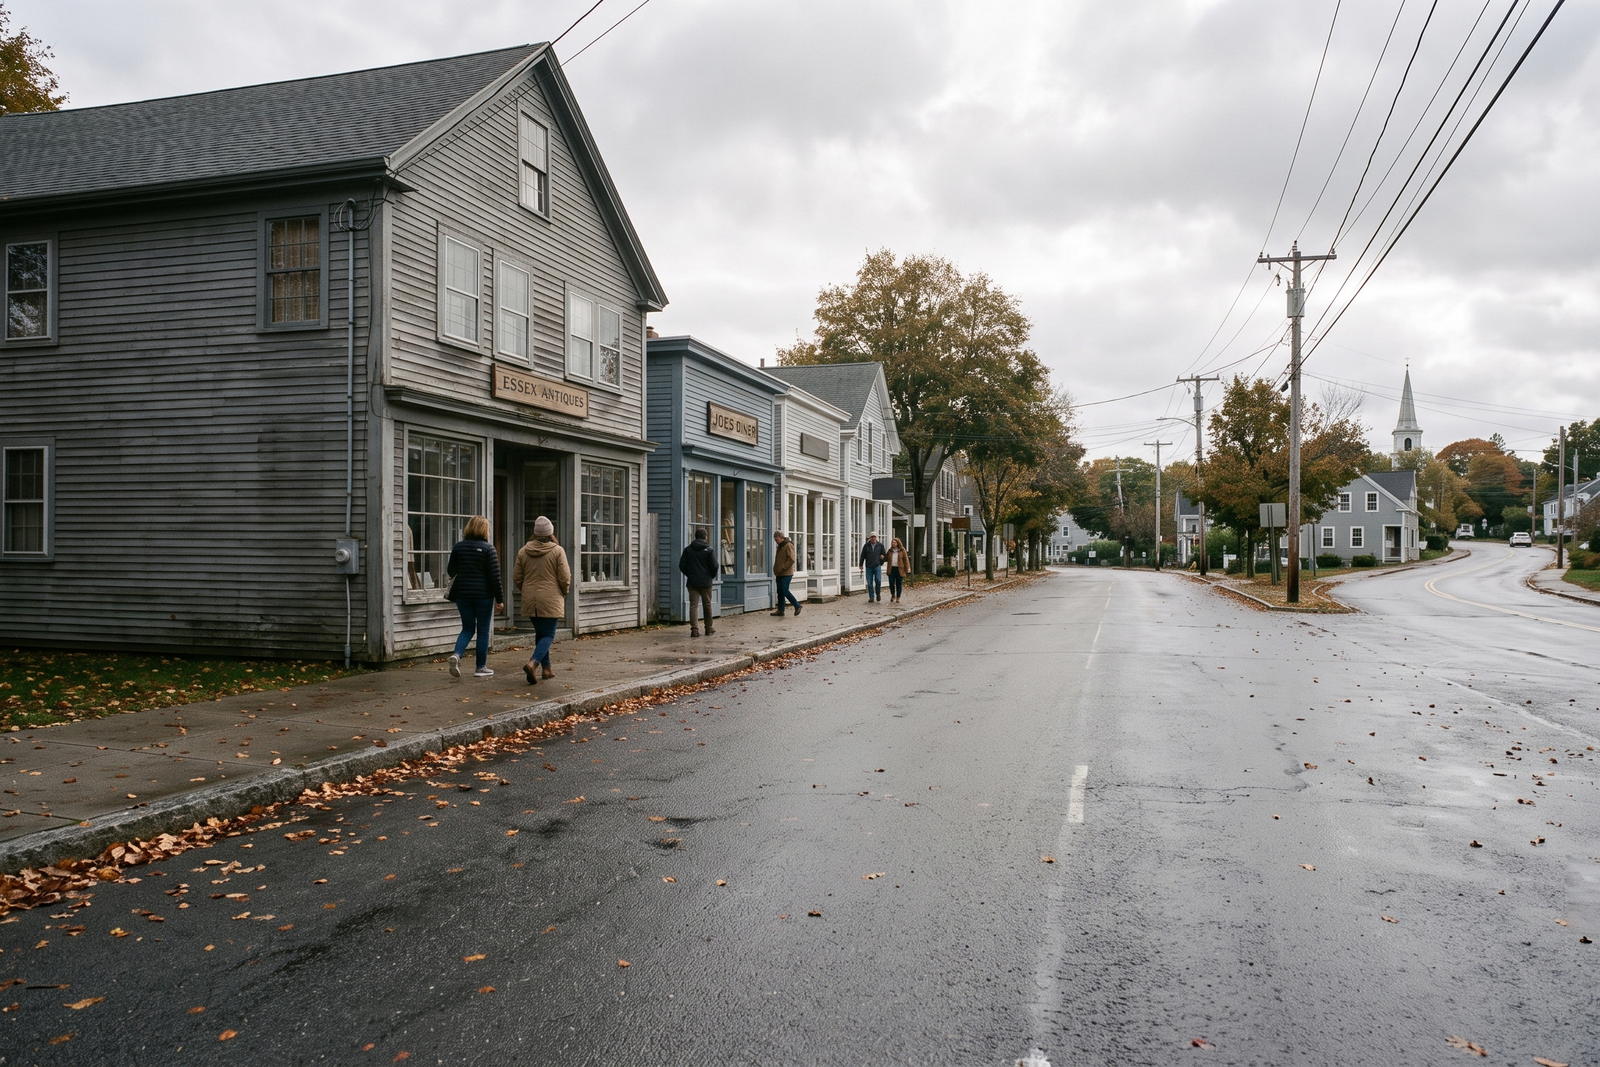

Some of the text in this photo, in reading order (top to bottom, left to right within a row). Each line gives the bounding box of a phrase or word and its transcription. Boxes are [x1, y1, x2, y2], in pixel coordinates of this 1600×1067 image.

[503, 376, 584, 408] ESSEX ANTIQUES
[712, 413, 734, 431] JOES
